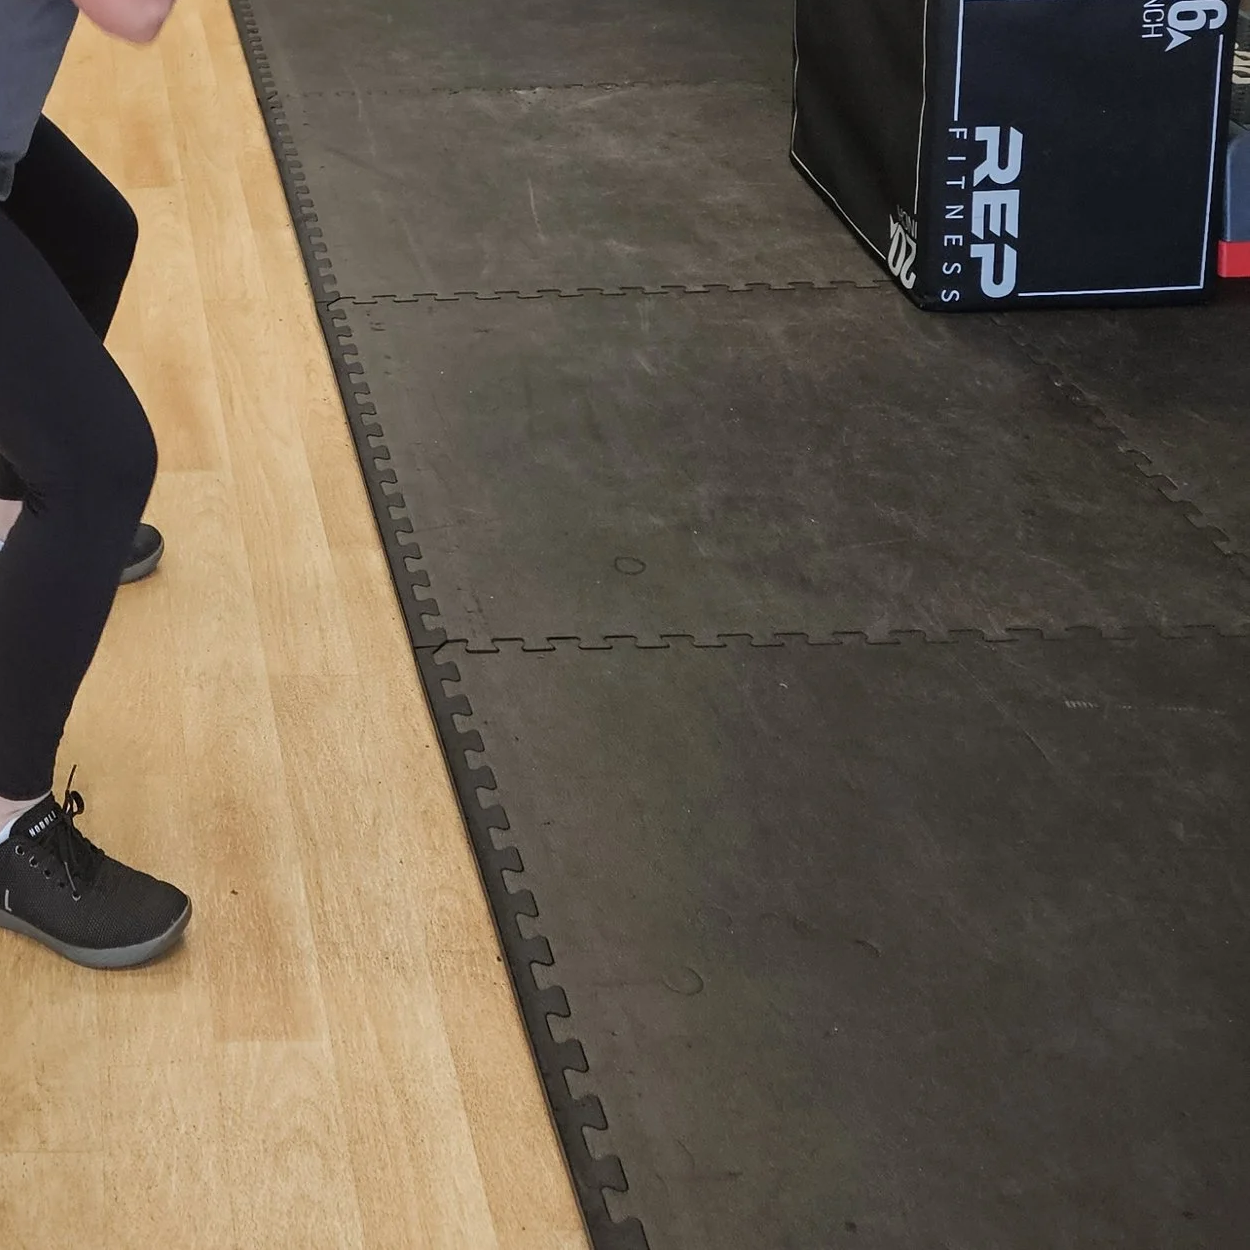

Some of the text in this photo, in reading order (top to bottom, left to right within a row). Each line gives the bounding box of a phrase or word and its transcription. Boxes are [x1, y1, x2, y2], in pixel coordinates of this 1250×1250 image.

[887, 222, 917, 289] 20
[941, 127, 968, 302] FITNESS
[970, 126, 1023, 299] REP
